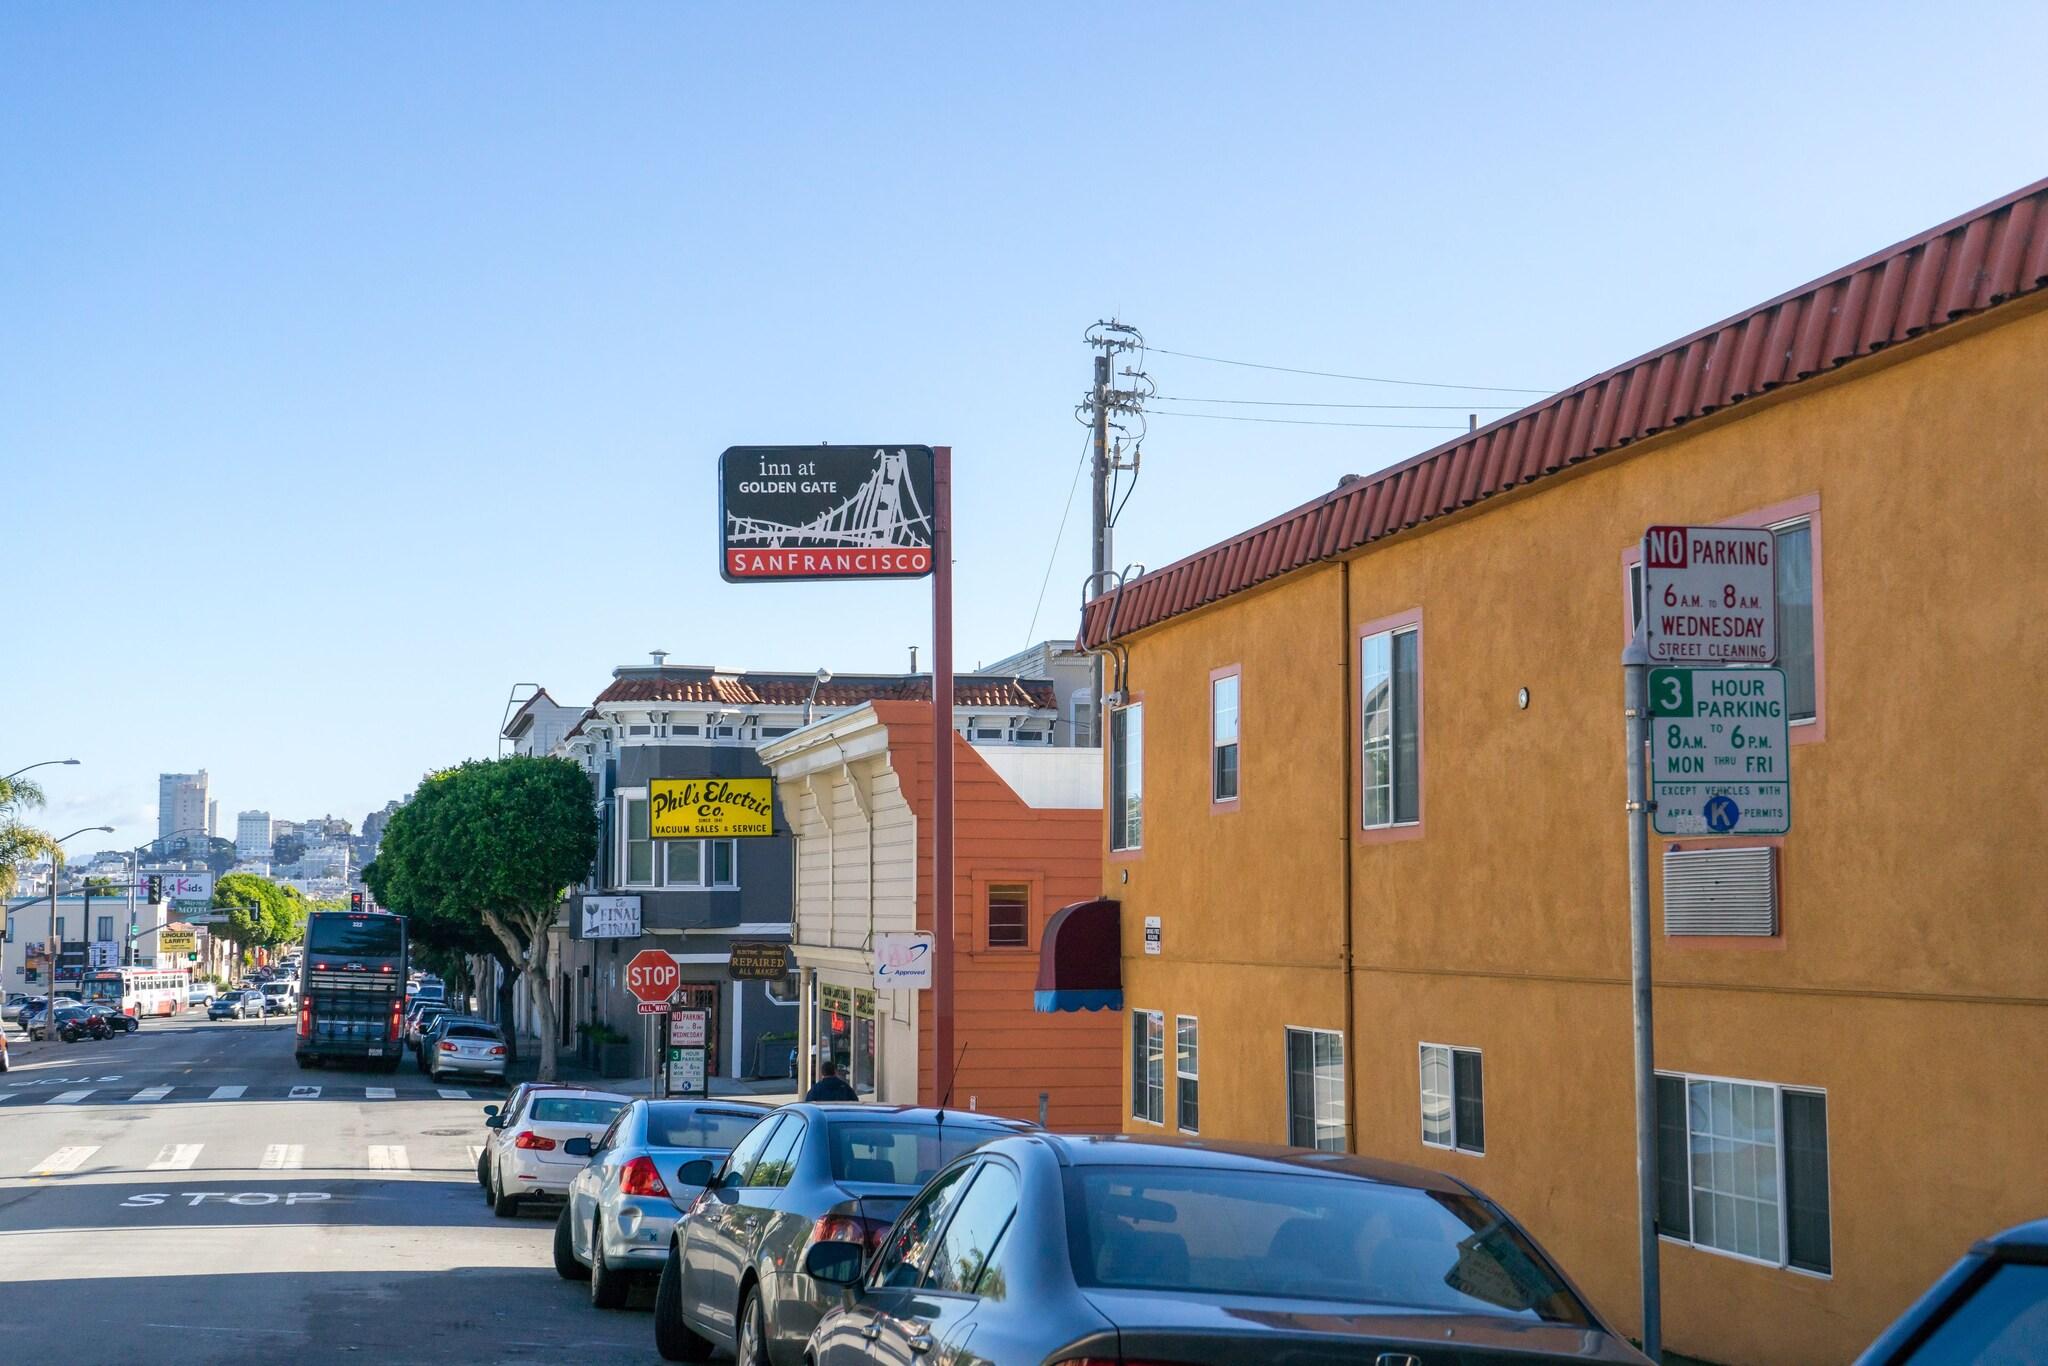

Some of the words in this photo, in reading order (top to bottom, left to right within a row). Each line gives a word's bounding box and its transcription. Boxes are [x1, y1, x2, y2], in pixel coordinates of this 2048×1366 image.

[759, 455, 792, 476] inn
[798, 460, 816, 476] at
[739, 481, 797, 494] GOLDEN
[800, 481, 837, 494] GATE
[1651, 530, 1683, 564] NO
[1693, 540, 1768, 566] PARKING
[1709, 600, 1718, 608] TO
[1661, 616, 1764, 638] WEDNESDAY
[1658, 643, 1702, 656] STREET
[1708, 644, 1766, 658] CLEANING
[1661, 676, 1682, 710] 3
[1712, 680, 1764, 696] HOUR
[1697, 701, 1781, 718] PARKING
[1711, 724, 1723, 733] TO
[1668, 756, 1704, 773] MON
[1714, 756, 1736, 766] THRU
[1746, 756, 1772, 773] FRI
[1662, 786, 1696, 796] EXCEPT
[1705, 786, 1750, 796] VEHICLES
[1758, 787, 1780, 795] WITH
[653, 783, 700, 820] Phil's
[703, 781, 771, 816] Electric
[1712, 801, 1731, 826] K
[1744, 808, 1783, 818] PERMITS
[695, 825, 719, 833] SALES
[733, 824, 767, 832] SERVICE
[600, 908, 639, 921] FINAL
[600, 922, 639, 936] FINAL
[732, 957, 784, 967] REPAIRED
[631, 966, 676, 986] STOP
[739, 968, 752, 976] ALL
[672, 1012, 681, 1021] NO
[672, 1051, 679, 1060] 3
[119, 1192, 331, 1207] STOP
